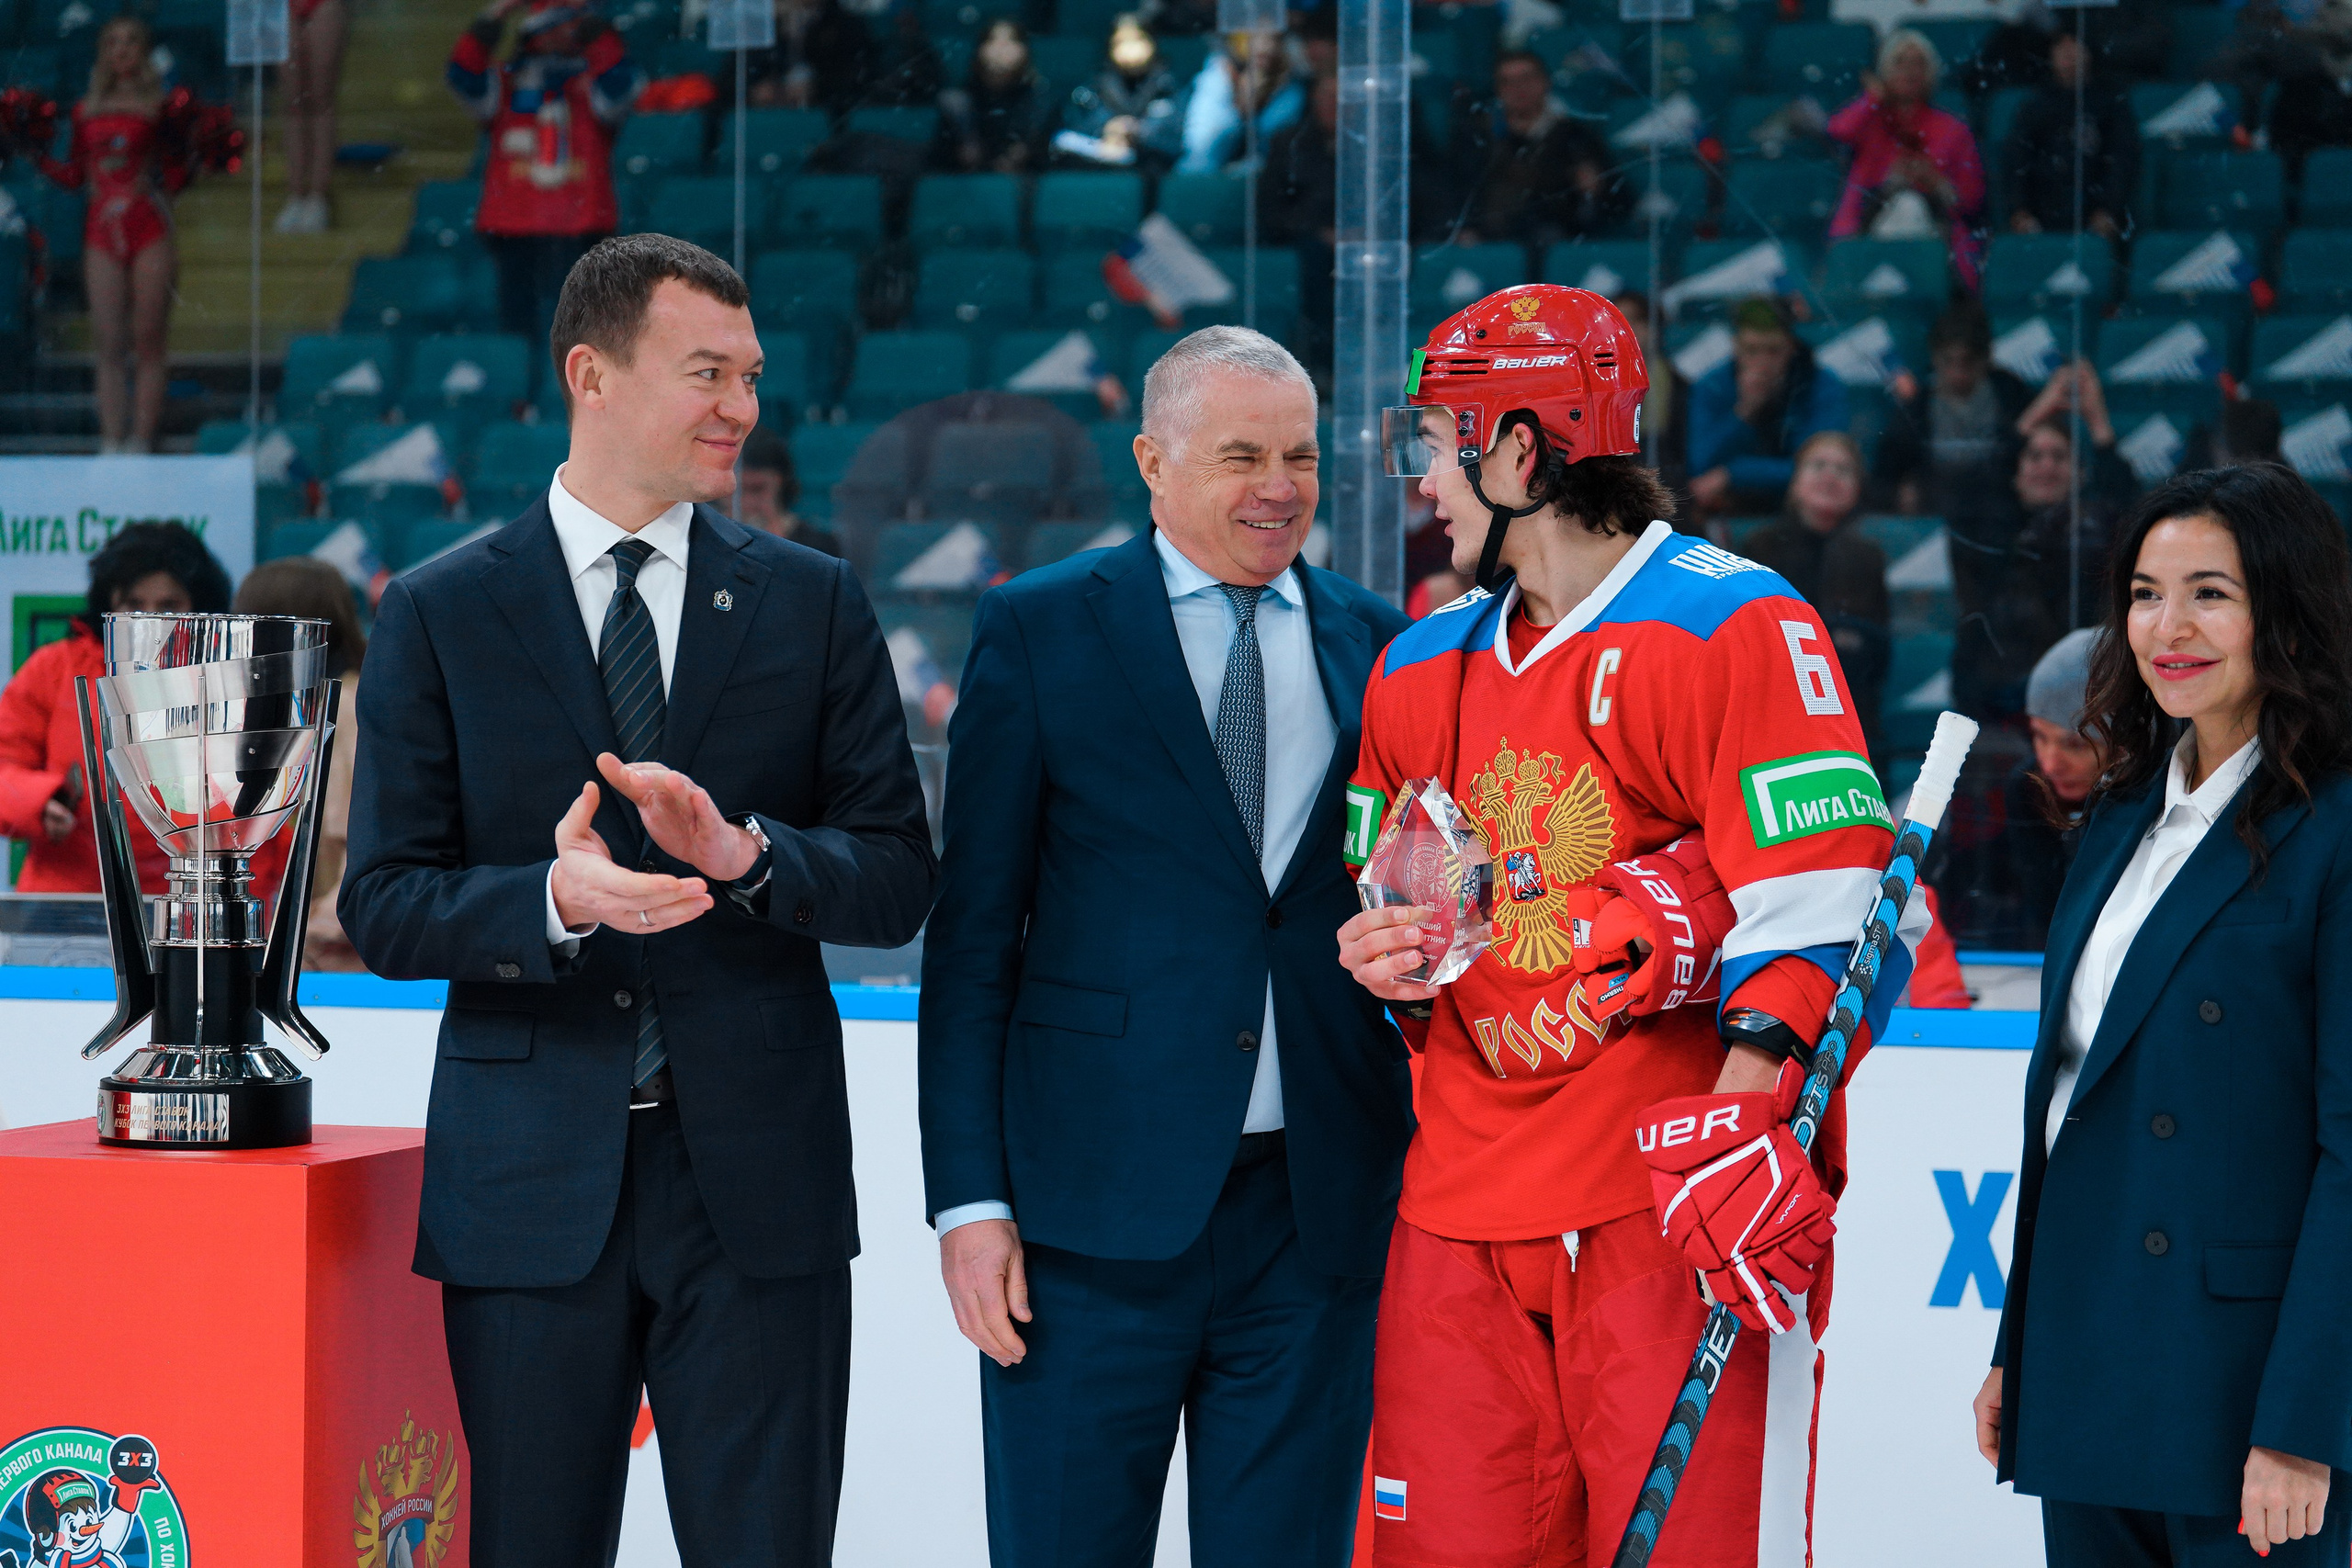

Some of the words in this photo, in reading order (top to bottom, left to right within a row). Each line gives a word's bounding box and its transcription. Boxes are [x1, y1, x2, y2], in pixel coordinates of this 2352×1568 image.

[1780, 620, 1845, 716] 6
[1474, 978, 1633, 1078] РОСС
[114, 1118, 137, 1130] КУБОК
[44, 1443, 102, 1464] КАНАЛА
[381, 1498, 406, 1530] ХОККЕЙ
[408, 1498, 433, 1514] РОССИИ
[154, 1517, 172, 1539] ПО
